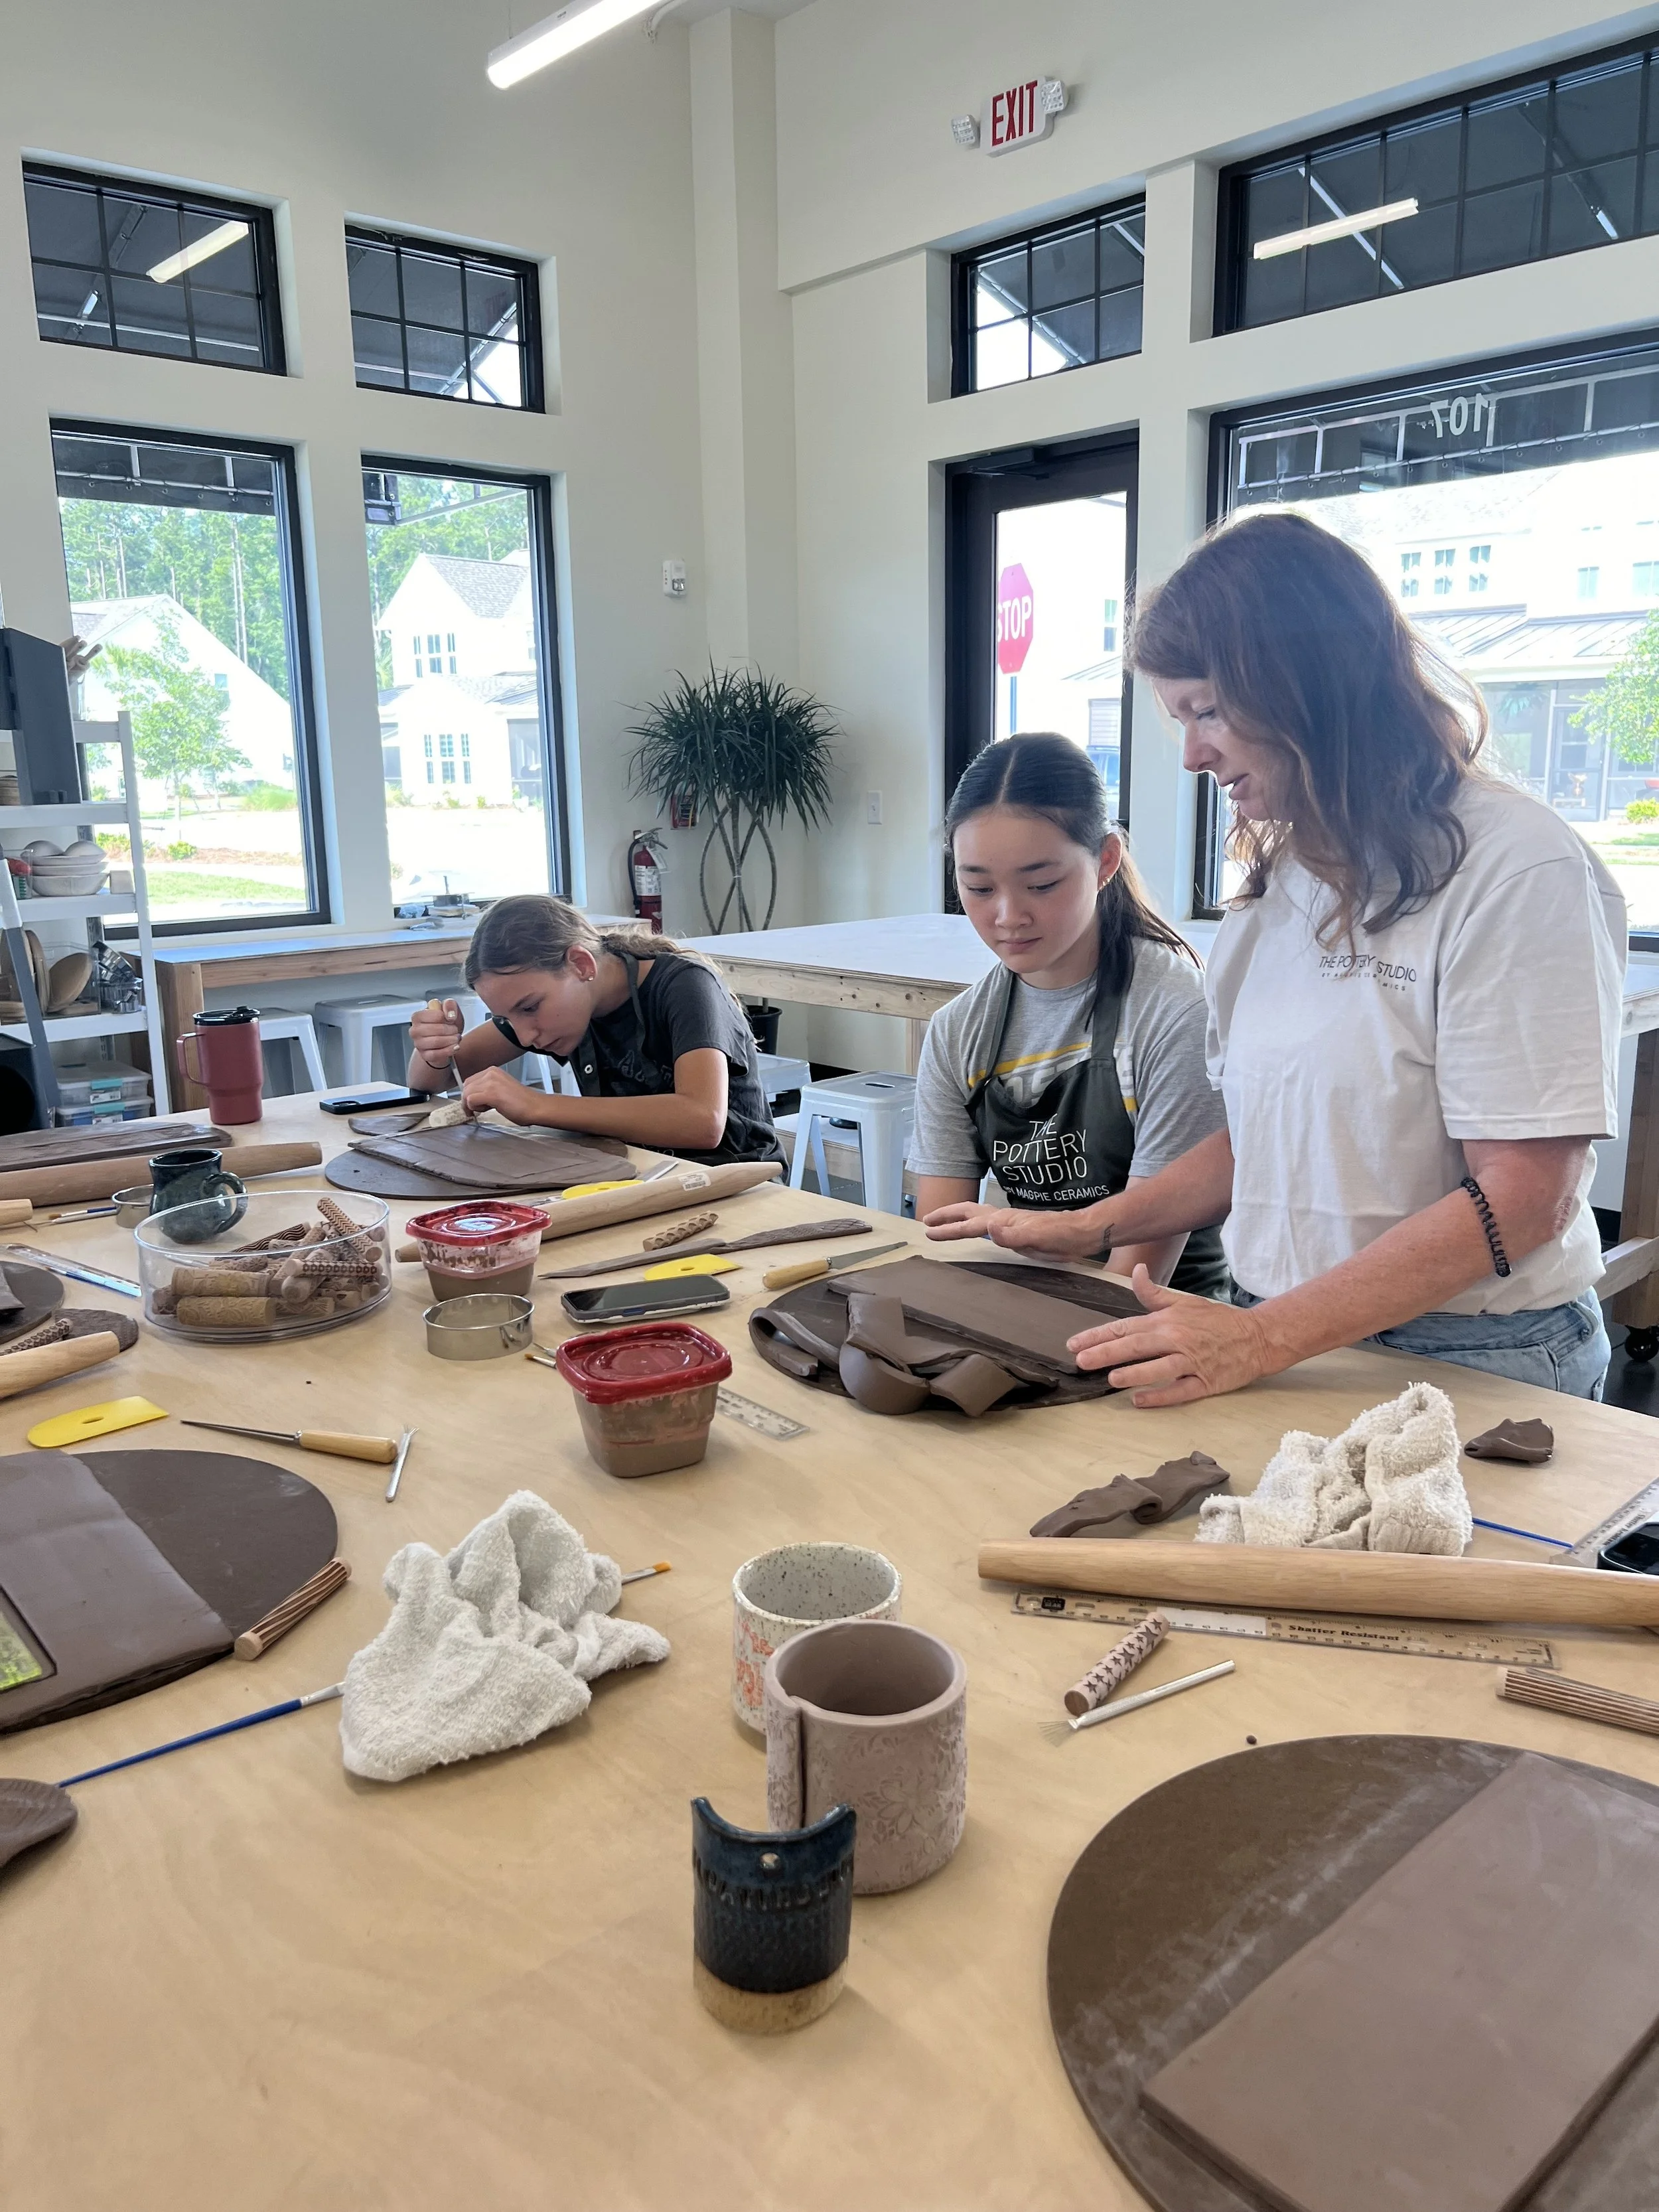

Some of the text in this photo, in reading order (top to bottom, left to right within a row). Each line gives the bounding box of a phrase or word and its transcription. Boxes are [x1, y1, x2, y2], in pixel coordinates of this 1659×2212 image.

[992, 80, 1038, 147] EXIT
[997, 595, 1032, 643] STOP
[1319, 955, 1337, 968] THE
[1337, 954, 1376, 968] POTERY
[1376, 960, 1417, 982] STUDIO
[1029, 1112, 1058, 1142] THE
[993, 1128, 1087, 1163] POTTERY
[1002, 1155, 1088, 1185] STUDIO
[1015, 1187, 1052, 1202] MAGPIE
[1053, 1185, 1110, 1201] CERAMICS
[1289, 1624, 1400, 1641] Shatter Resistant
